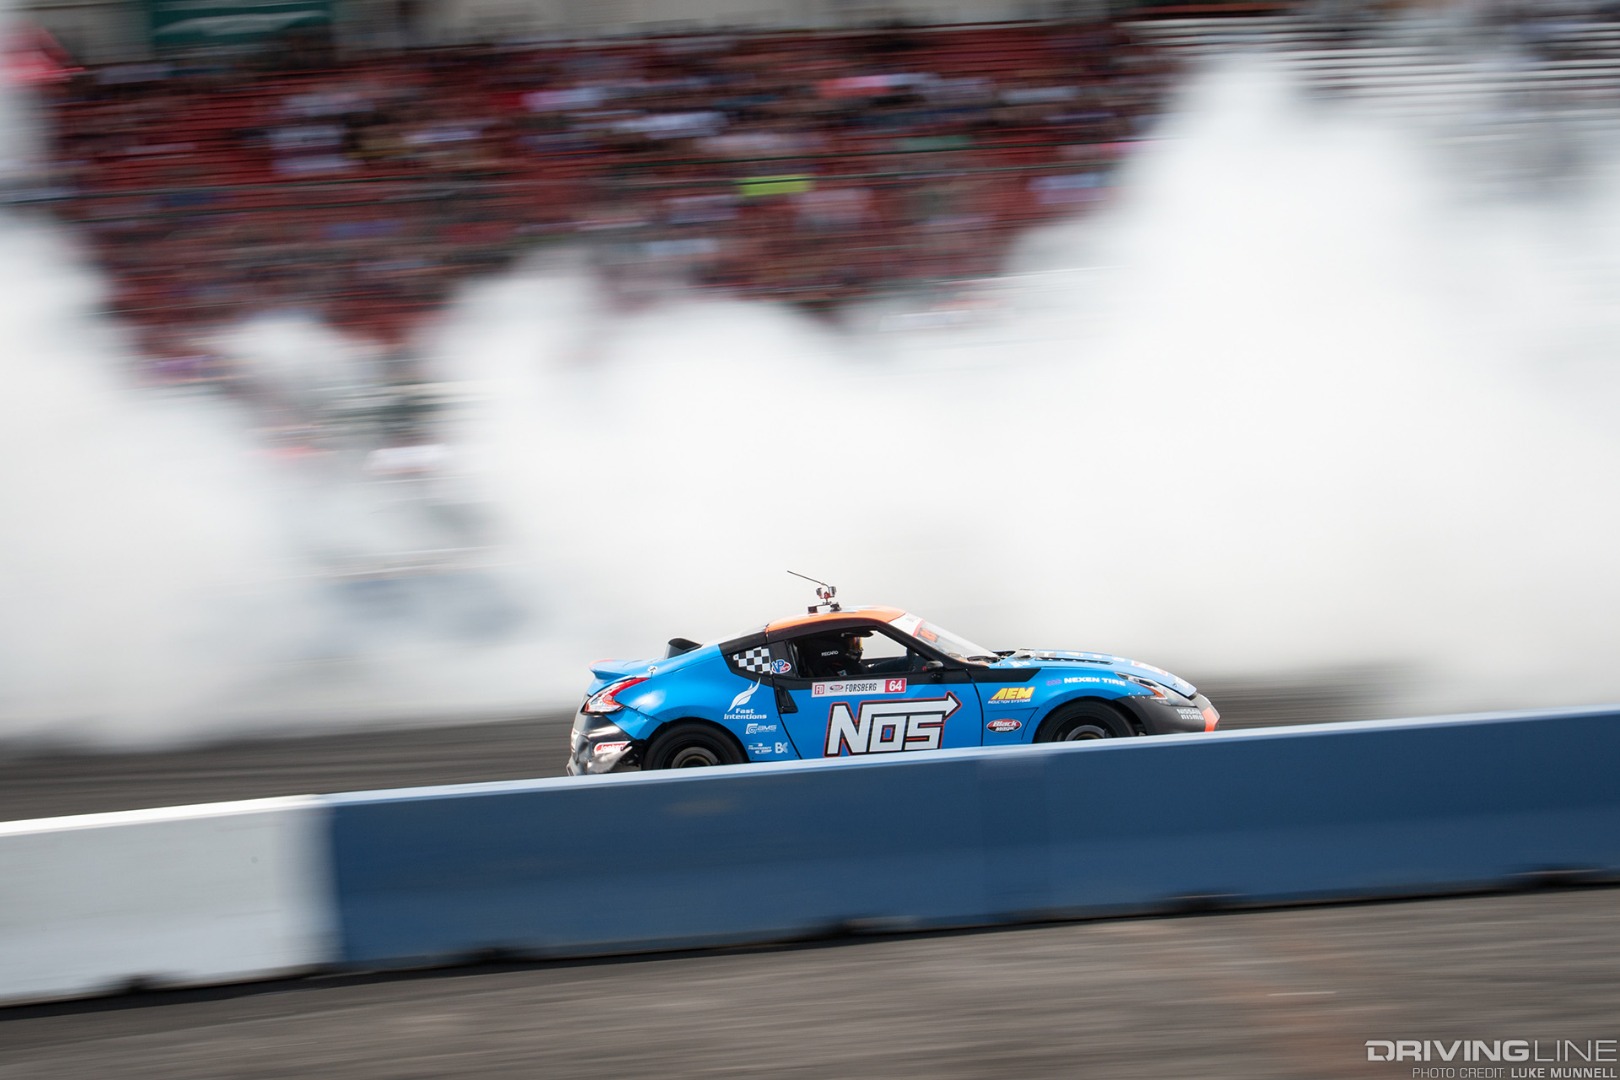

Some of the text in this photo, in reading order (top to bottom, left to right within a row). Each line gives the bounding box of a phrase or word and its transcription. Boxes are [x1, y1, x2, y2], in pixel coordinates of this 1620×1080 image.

[844, 682, 878, 693] FORSBERG
[888, 680, 903, 692] 64
[1103, 678, 1126, 686] TIRE
[990, 686, 1035, 700] AEM
[824, 694, 958, 757] NOS
